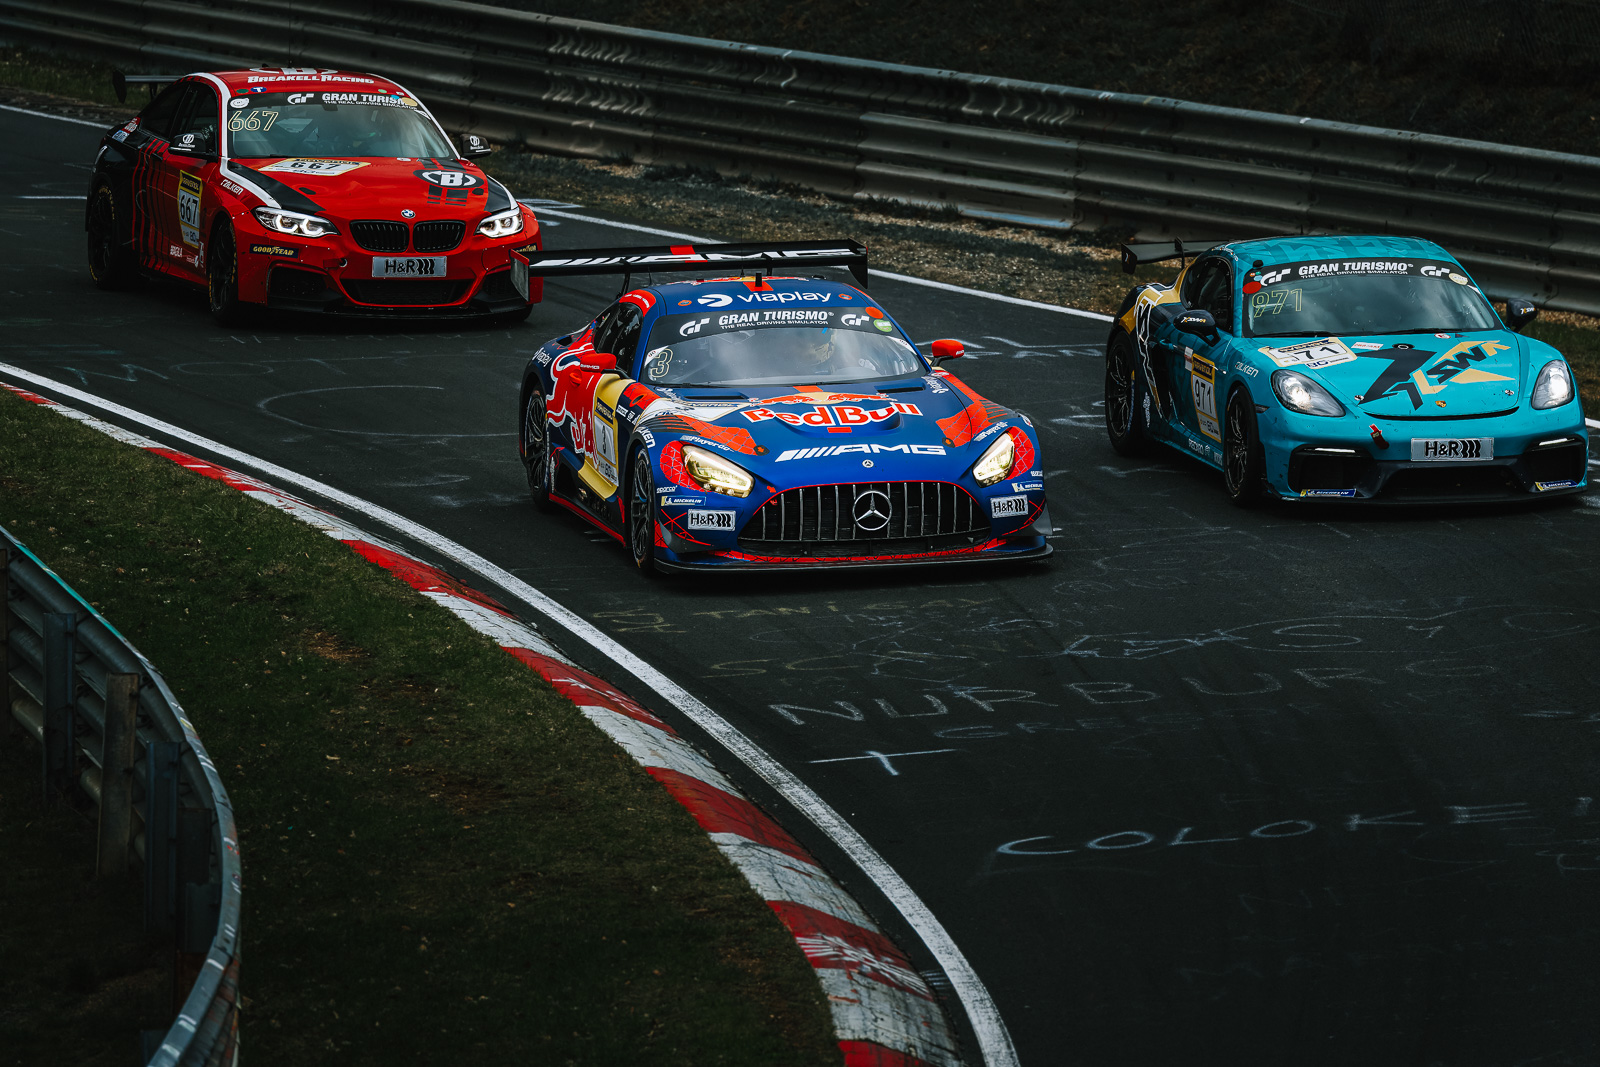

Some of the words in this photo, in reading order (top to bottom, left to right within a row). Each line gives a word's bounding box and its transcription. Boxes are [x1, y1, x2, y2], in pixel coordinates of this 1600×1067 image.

[247, 75, 320, 83] BREAKELL
[320, 75, 375, 84] RACING
[322, 93, 357, 102] GRAN
[361, 94, 409, 106] TURISM
[228, 110, 279, 131] 667
[290, 162, 341, 170] 667
[220, 179, 244, 195] FALKEN
[180, 194, 198, 225] 667
[253, 245, 294, 256] GOODYEAR
[384, 258, 418, 275] H&R
[1298, 263, 1339, 276] GRAN
[737, 291, 831, 305] viaplay
[1251, 289, 1303, 318] 971
[718, 312, 760, 326] GRAN
[650, 348, 674, 378] 3
[1194, 379, 1213, 414] 971
[740, 405, 832, 427] Red
[832, 402, 923, 427] Bull
[833, 444, 947, 456] AMG
[1424, 441, 1460, 458] H&R
[993, 500, 1014, 514] H&R
[690, 513, 715, 526] H&R
